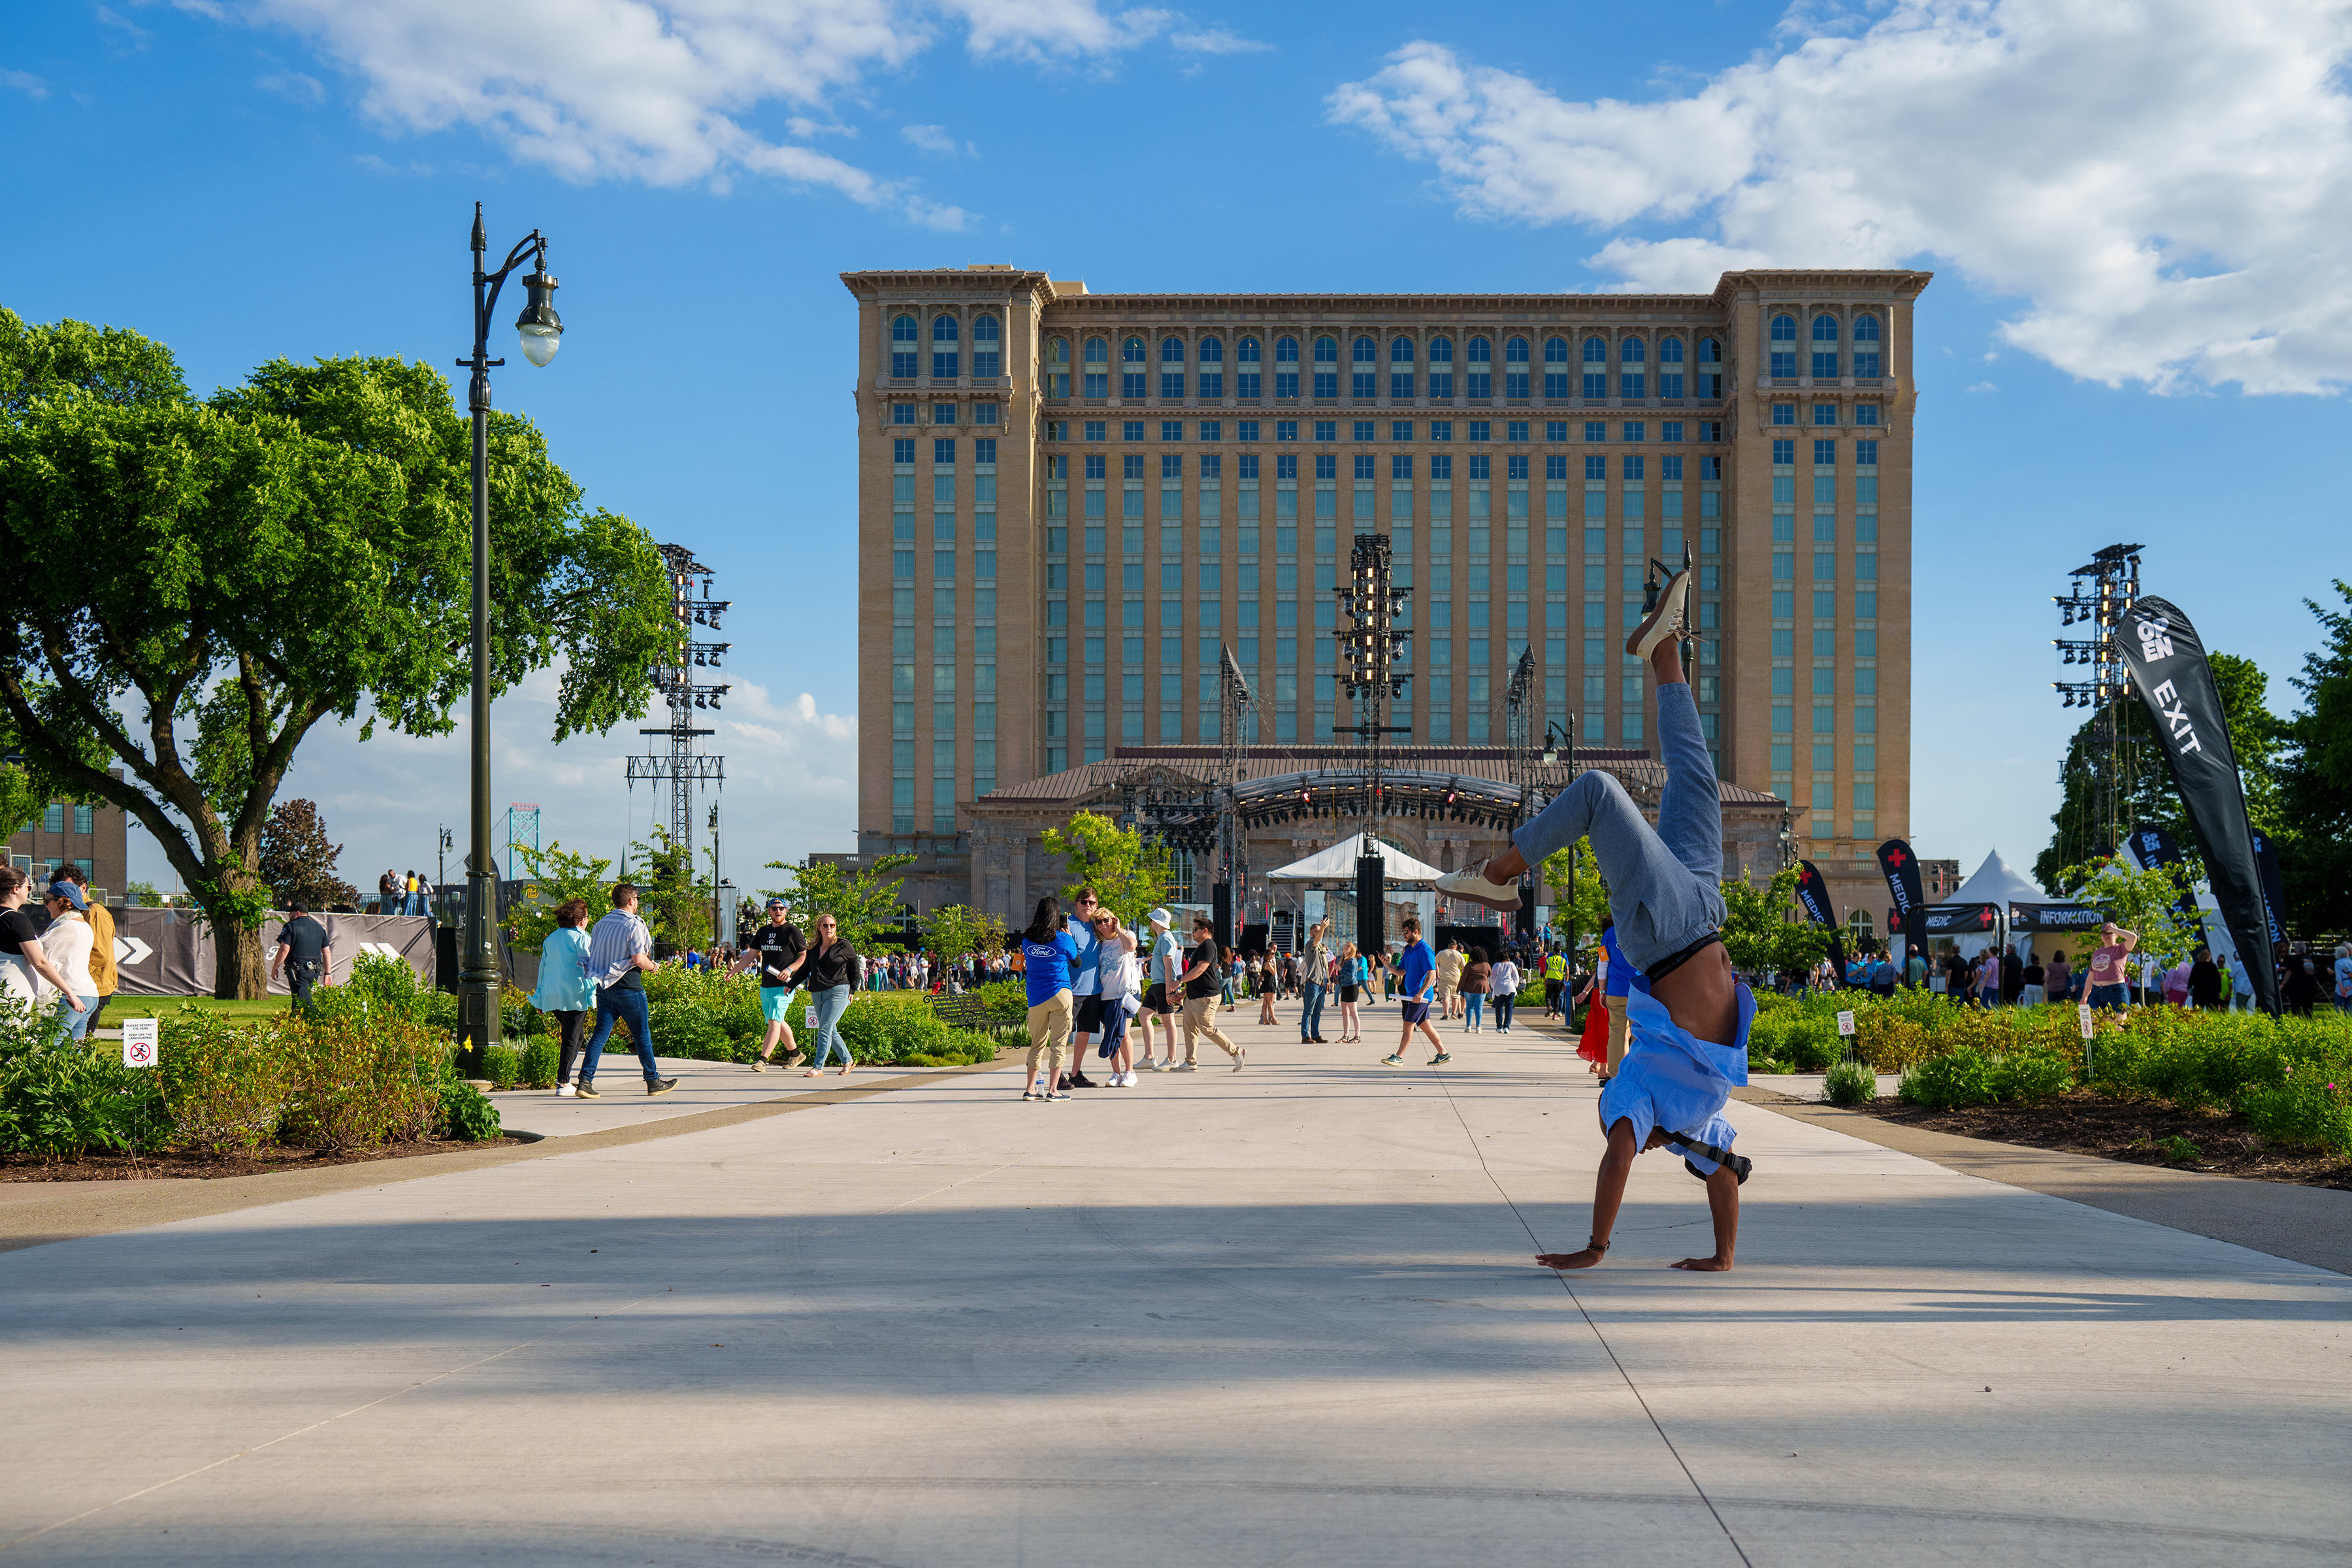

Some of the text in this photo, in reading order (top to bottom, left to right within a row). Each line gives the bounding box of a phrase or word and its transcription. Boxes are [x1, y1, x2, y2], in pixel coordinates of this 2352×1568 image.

[2153, 678, 2202, 755] EXIT
[1889, 873, 1911, 915] MEDIC
[1801, 889, 1825, 924] MEDIC
[1925, 915, 1952, 927] MEDIC
[2040, 910, 2104, 924] INFORMATION
[1031, 947, 1051, 955] Ford
[1675, 953, 1688, 963] PAIR
[1653, 965, 1671, 979] THIEVES
